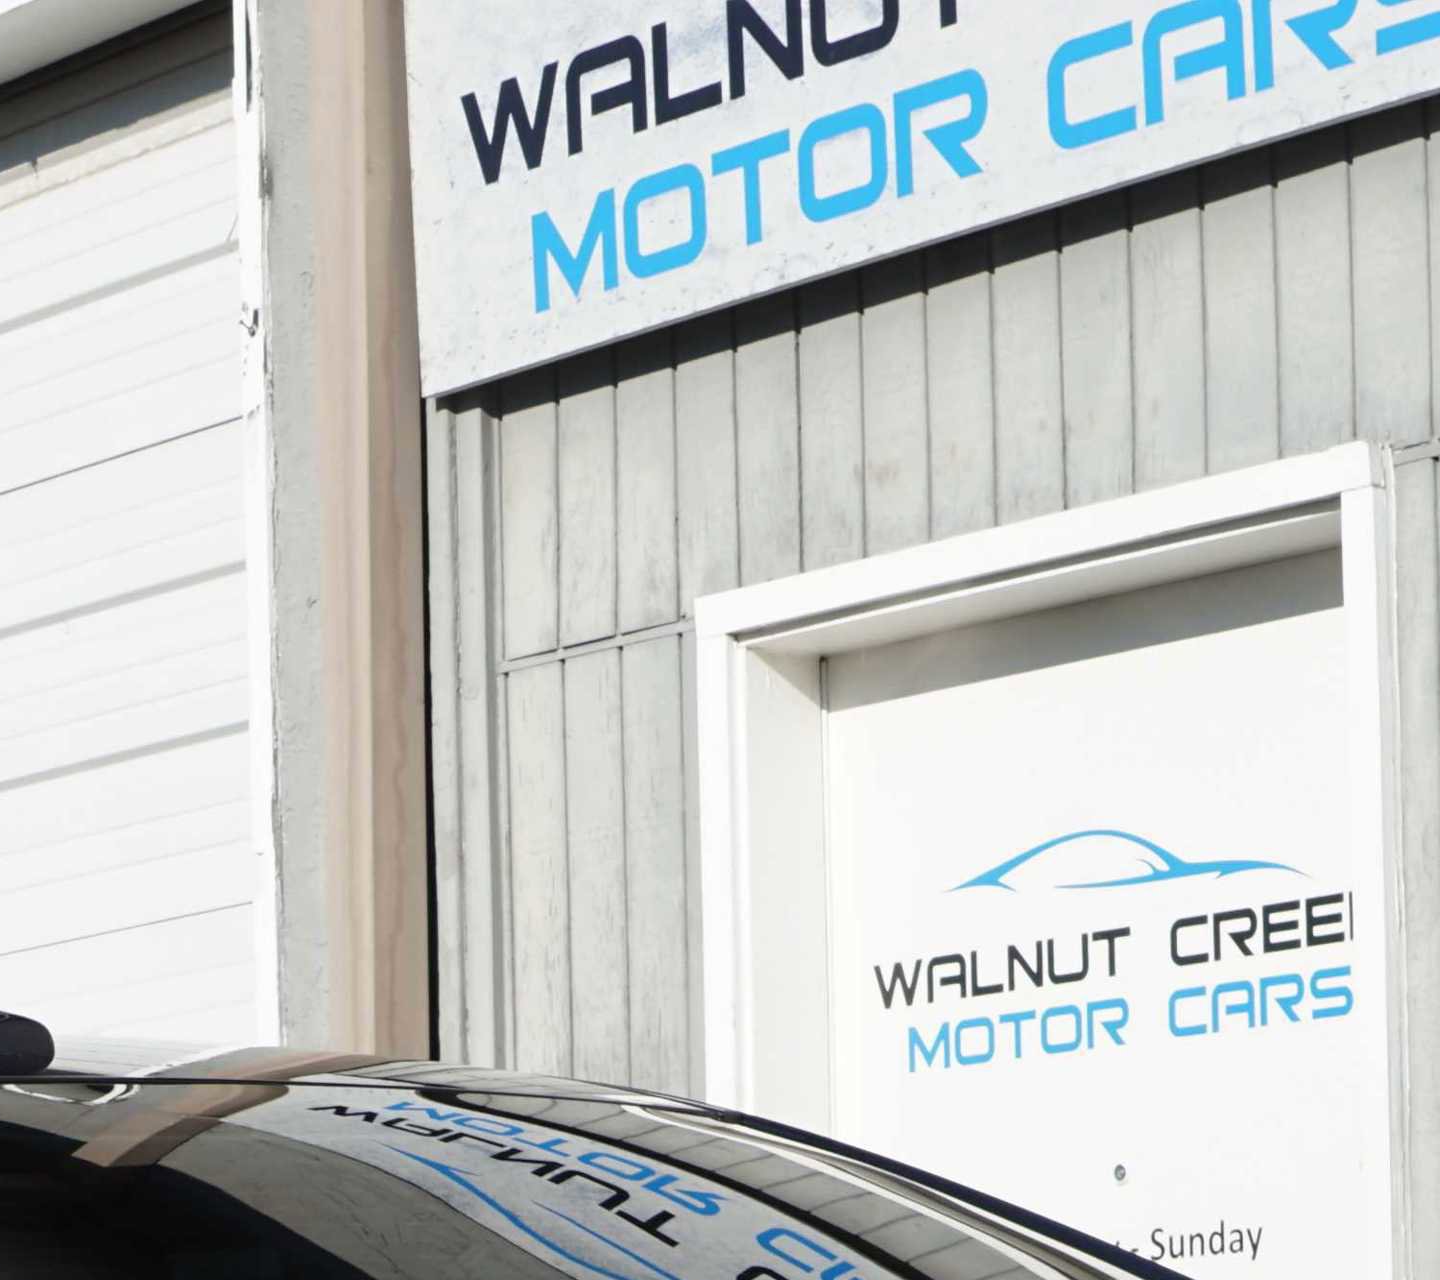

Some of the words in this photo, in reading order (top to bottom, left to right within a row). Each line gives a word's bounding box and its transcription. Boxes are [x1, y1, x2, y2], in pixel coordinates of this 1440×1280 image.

[530, 68, 989, 313] MOTOR
[873, 926, 1131, 1010] WALNUT
[1169, 890, 1354, 967] CREE
[907, 997, 1130, 1073] MOTOR
[1167, 965, 1354, 1038] CARS
[1150, 1219, 1263, 1262] Sunday
